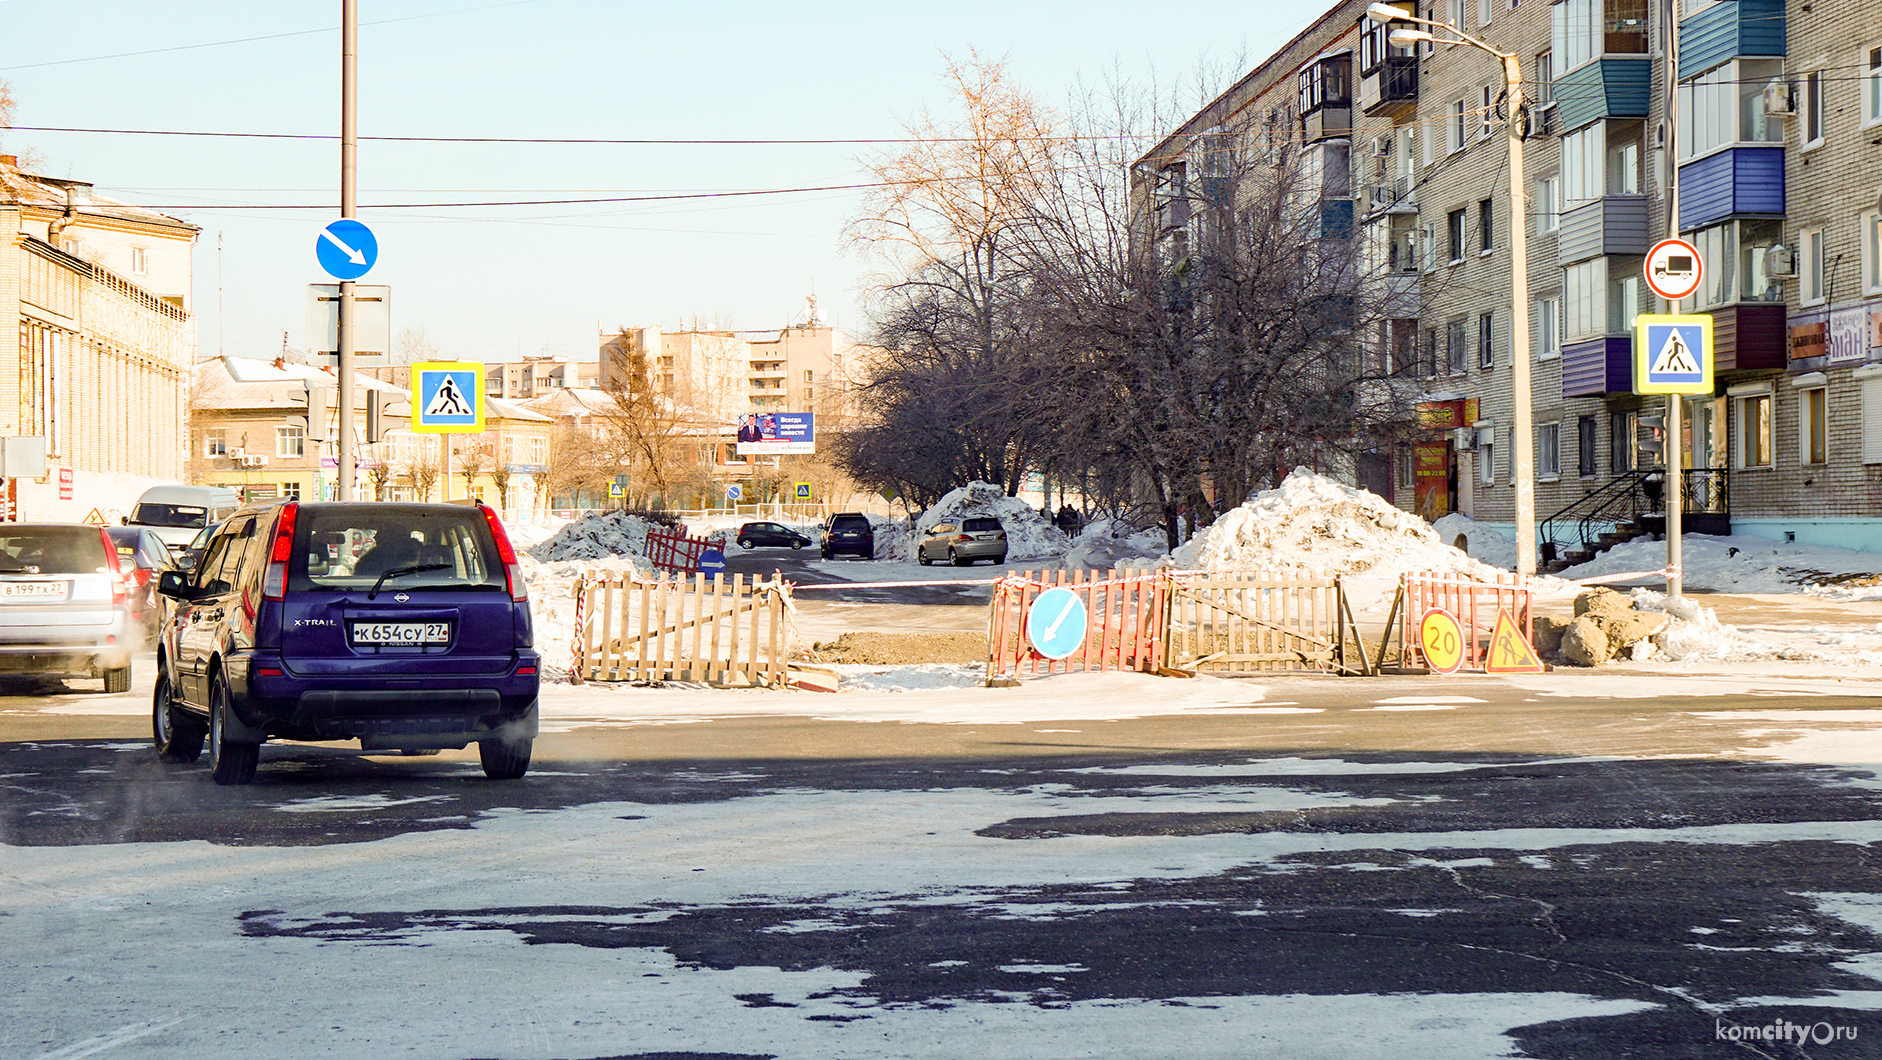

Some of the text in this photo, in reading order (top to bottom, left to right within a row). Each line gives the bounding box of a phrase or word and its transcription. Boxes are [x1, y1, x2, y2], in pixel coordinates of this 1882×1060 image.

[780, 416, 802, 424] Всегда
[51, 583, 62, 592] 27
[427, 624, 443, 636] 27
[1430, 626, 1455, 655] 20
